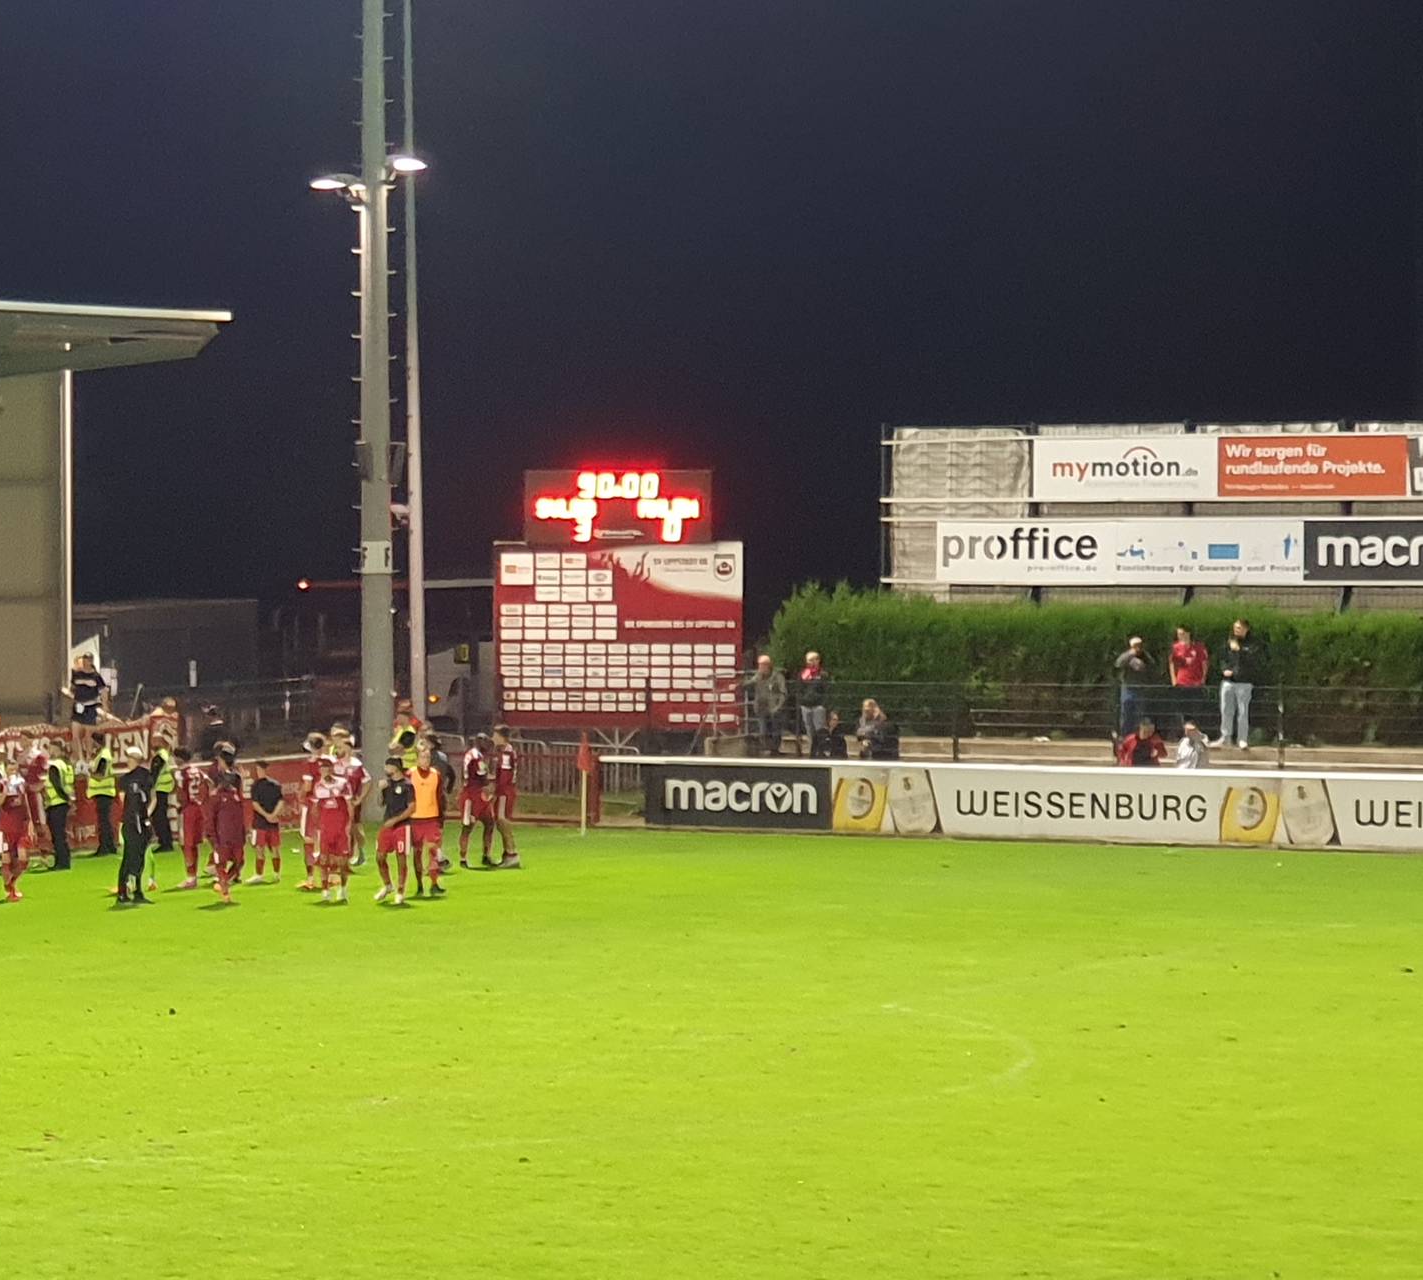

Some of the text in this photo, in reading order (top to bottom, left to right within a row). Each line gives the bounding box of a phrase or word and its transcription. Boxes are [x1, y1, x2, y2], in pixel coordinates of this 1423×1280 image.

[1225, 443, 1327, 461] Wir sorgen für
[1052, 455, 1198, 482] mymotion.de
[1225, 461, 1385, 477] rundlaufende Projekte.
[942, 527, 1098, 567] proffice
[1317, 536, 1423, 567] macr
[1198, 564, 1242, 572] Gewerbe
[1247, 564, 1266, 572] und
[1270, 564, 1300, 572] Privat
[665, 779, 818, 814] macron
[956, 789, 1207, 823] WEISSENBURG
[1354, 799, 1423, 829] WEI
